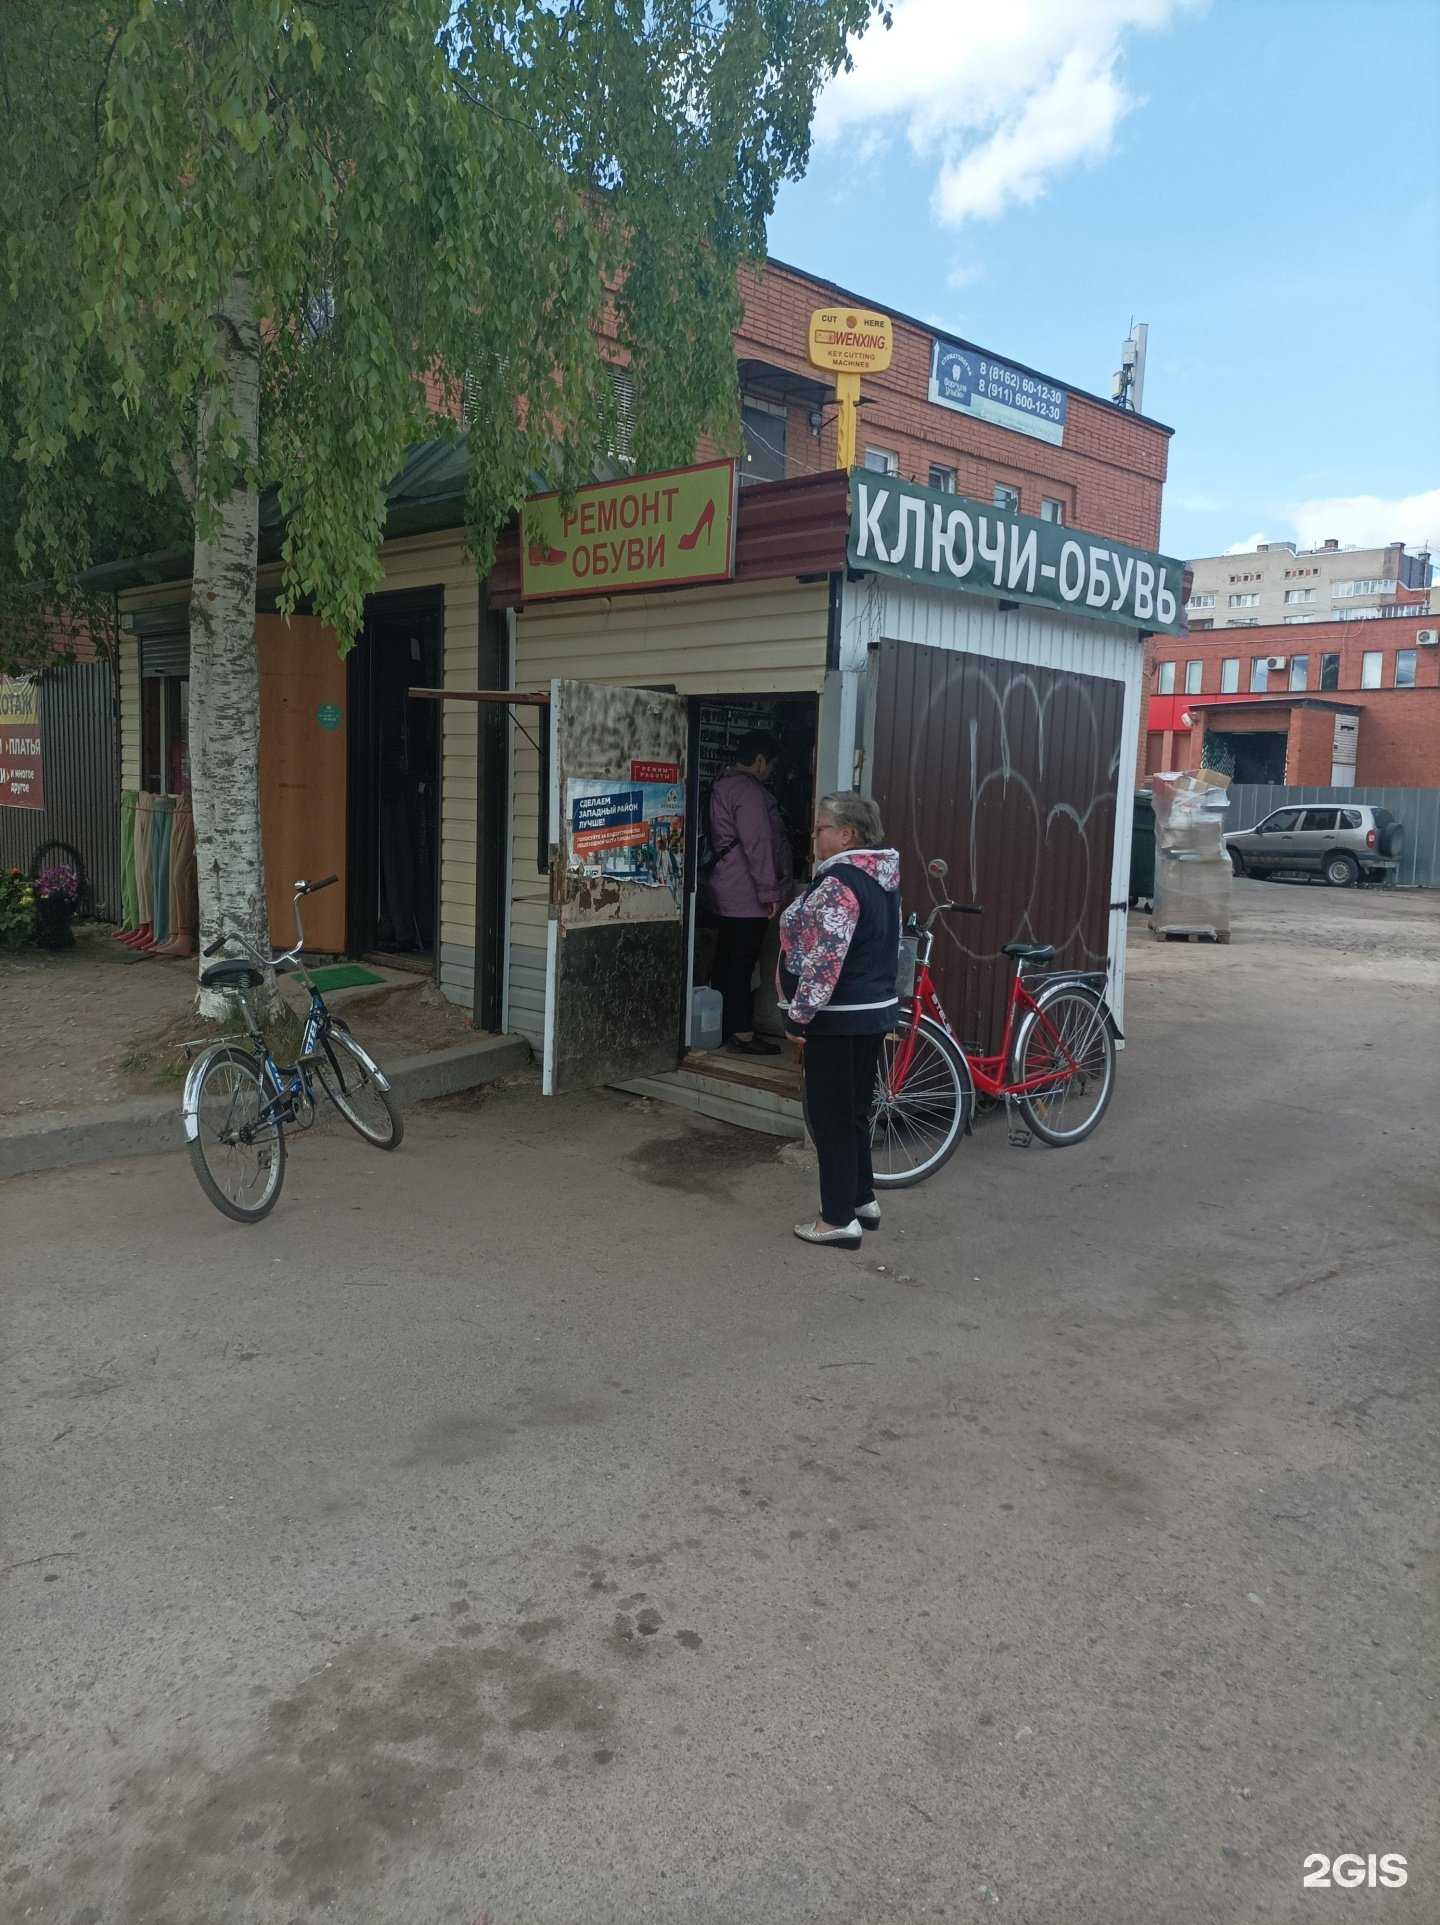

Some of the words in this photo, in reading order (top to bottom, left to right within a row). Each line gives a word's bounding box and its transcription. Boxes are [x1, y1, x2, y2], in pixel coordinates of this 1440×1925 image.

[821, 315, 837, 323] CUT
[864, 319, 885, 328] HERE
[834, 331, 886, 349] WENXING
[832, 359, 869, 368] MACHINES
[844, 351, 876, 360] CUTTING
[980, 362, 987, 375] 8
[989, 366, 1020, 391] (8162)
[1022, 378, 1062, 404] 60-12-30
[978, 379, 986, 392] 8
[987, 382, 1013, 405] (911)
[1015, 393, 1060, 420] 600-12-30
[563, 487, 679, 538] РЕМОНТ
[572, 534, 665, 577] ОБУВИ
[856, 483, 1177, 625] КЛЮЧИ-ОБУВЬ
[9, 738, 41, 755] ПЛАТЬЯ
[579, 796, 611, 808] СДЕЛАЕМ
[578, 804, 617, 818] ЗАПАДНЫЙ
